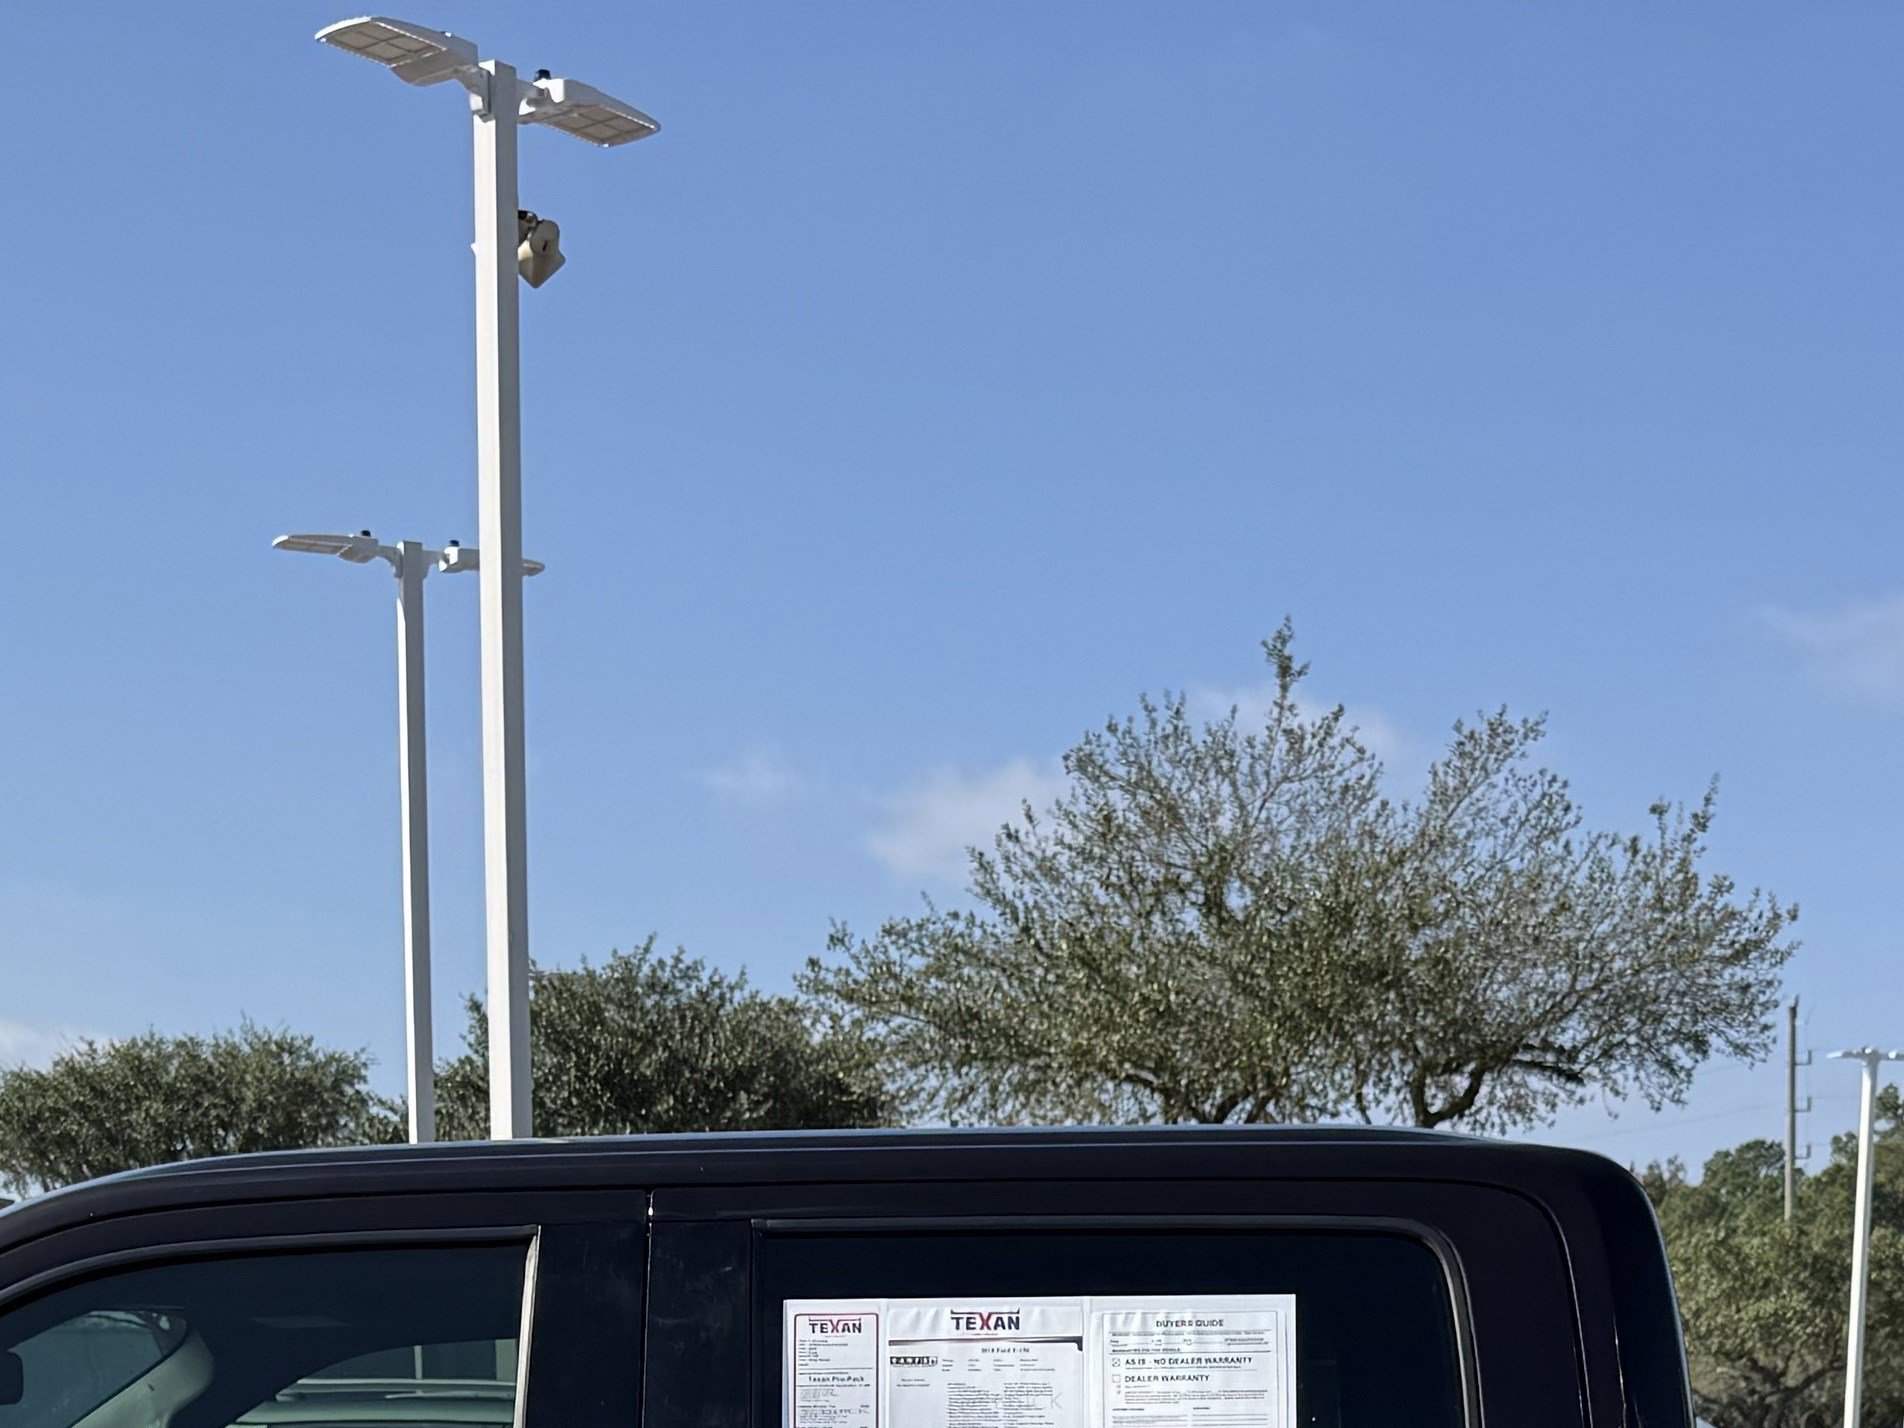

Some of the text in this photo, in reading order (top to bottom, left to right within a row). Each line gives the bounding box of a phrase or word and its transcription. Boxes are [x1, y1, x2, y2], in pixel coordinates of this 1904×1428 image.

[951, 1309, 1020, 1331] TEXAN
[1195, 1319, 1224, 1327] GUIDE
[809, 1318, 862, 1334] TEXAN
[1125, 1358, 1136, 1366] AS
[1162, 1374, 1210, 1382] WARRANTY
